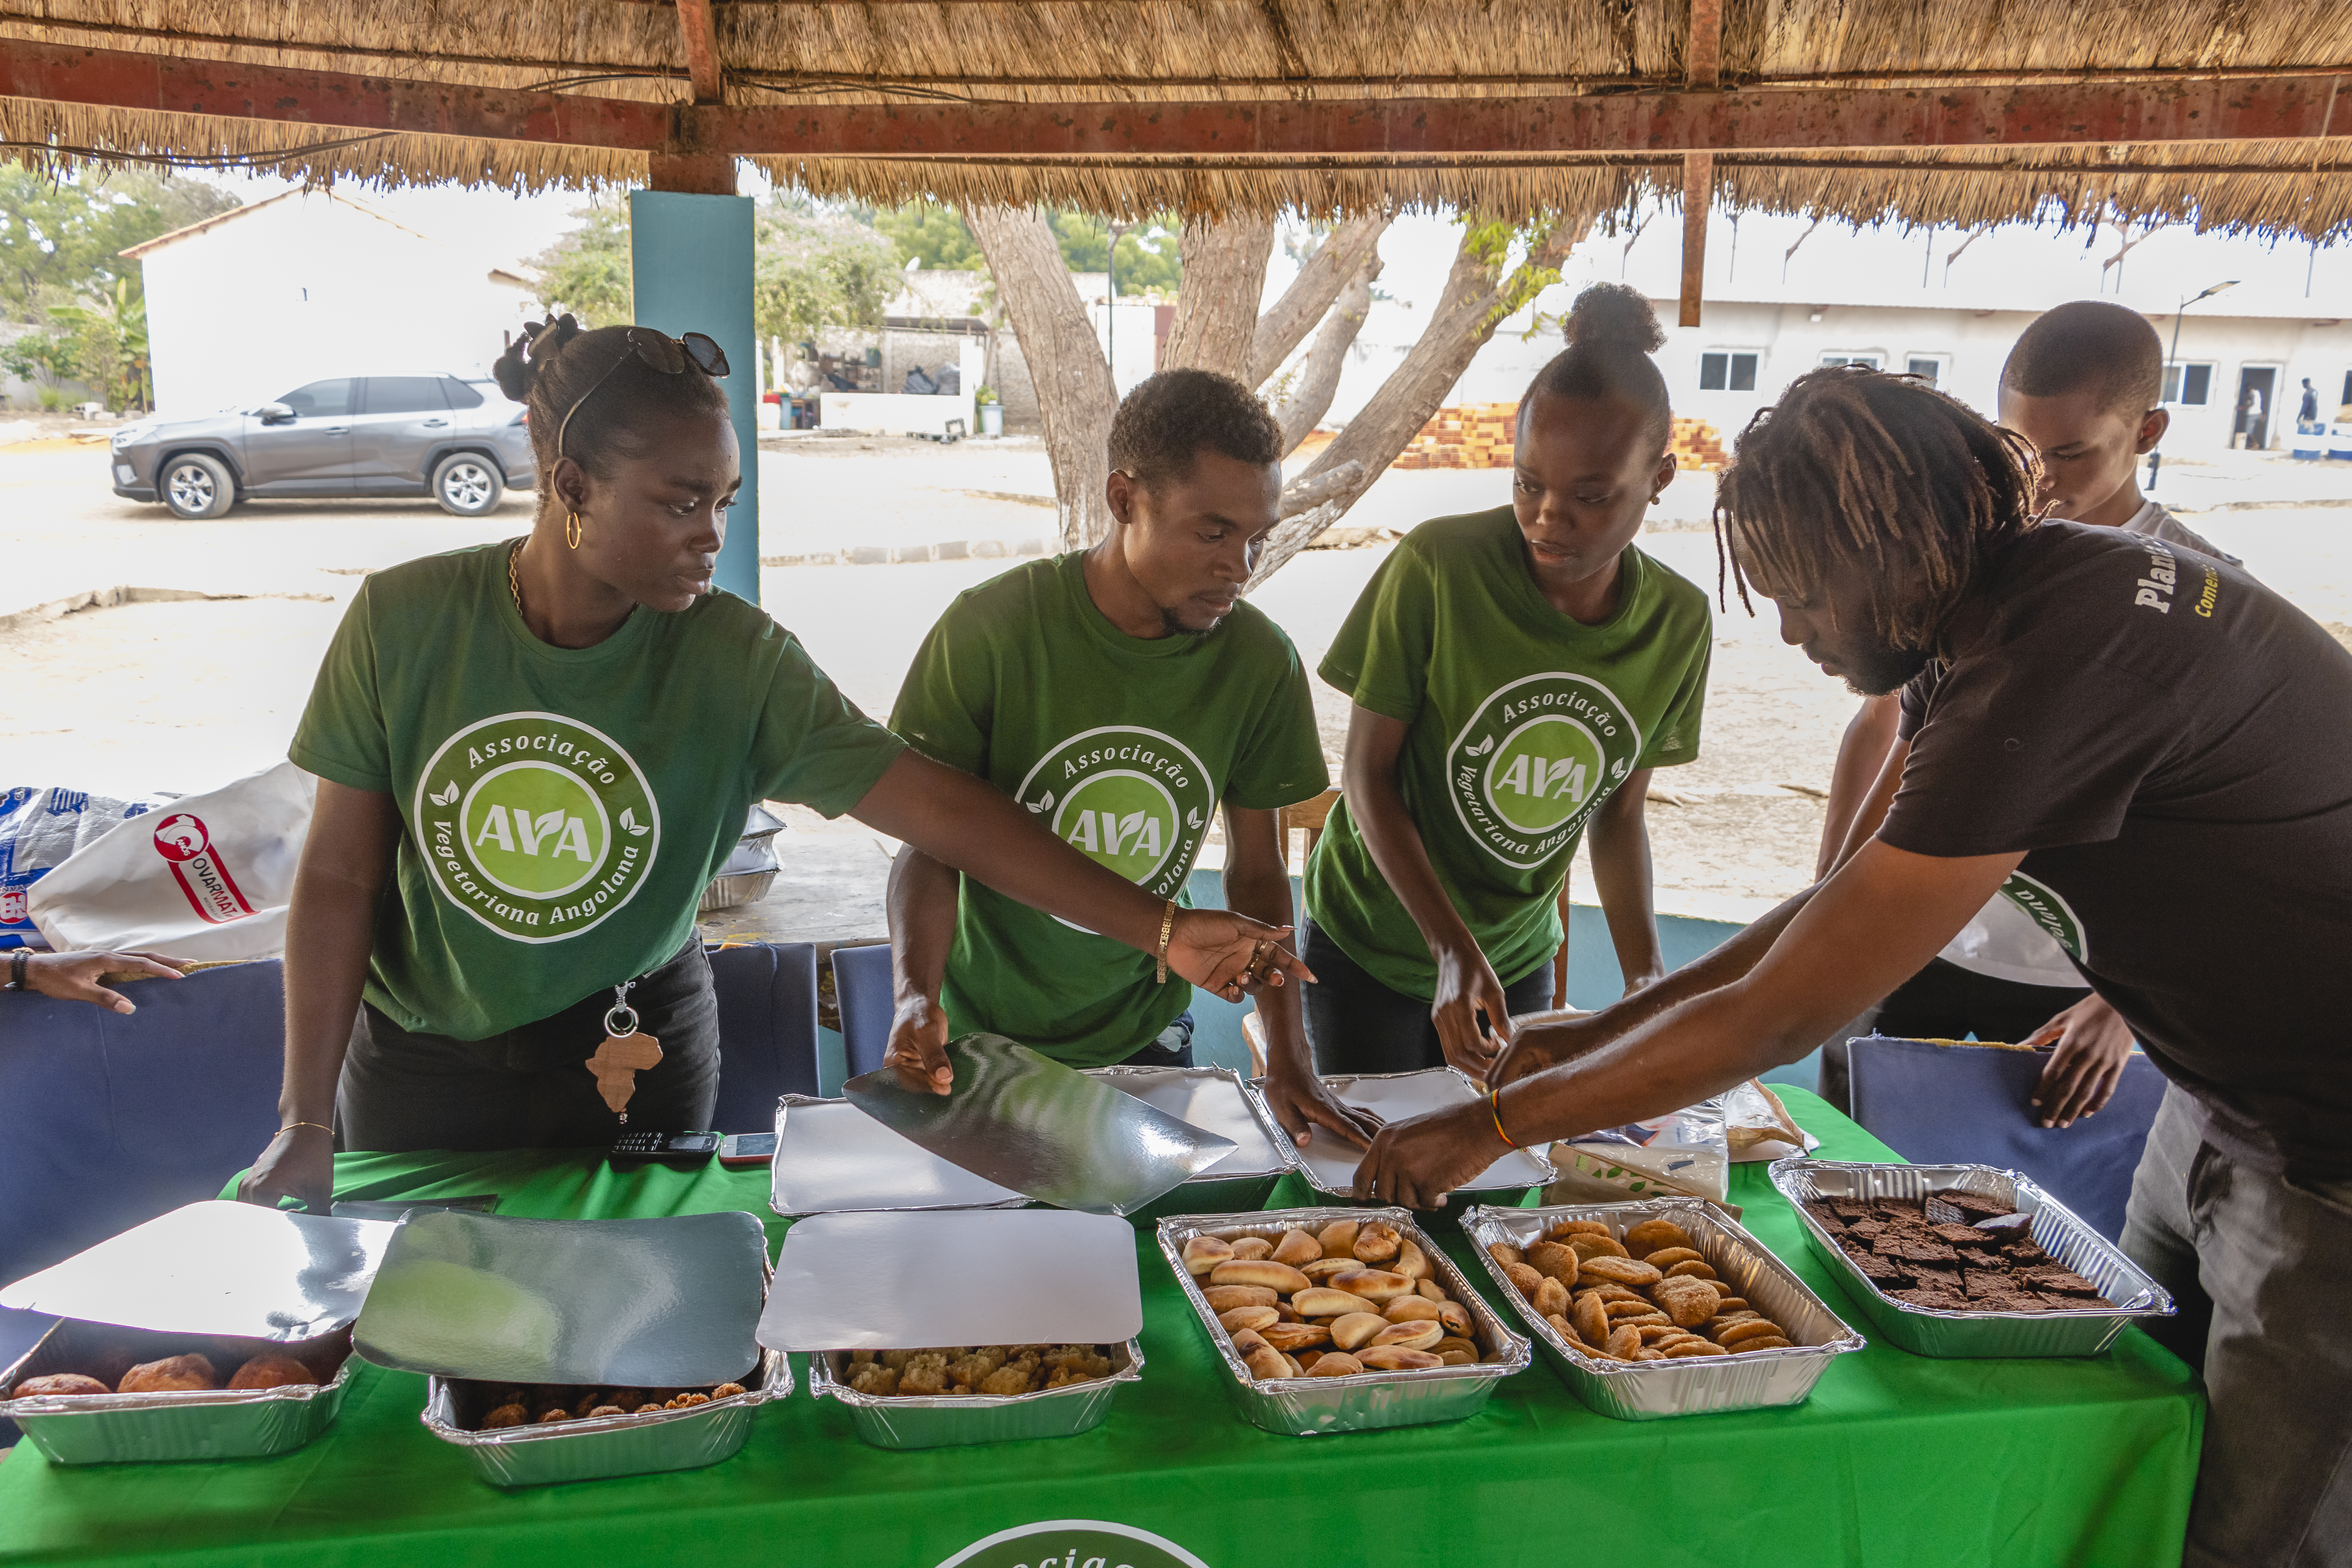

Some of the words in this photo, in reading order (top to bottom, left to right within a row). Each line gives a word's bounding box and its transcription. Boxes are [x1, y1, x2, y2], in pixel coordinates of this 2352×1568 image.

[1504, 691, 1617, 737] Associação
[468, 733, 615, 784] Associação
[1063, 744, 1188, 788] Associação
[1494, 753, 1586, 802] AVA
[475, 804, 592, 863] AVA
[1067, 809, 1161, 857] AVA
[1458, 765, 1530, 854] Vegetariana
[1533, 786, 1612, 855] Angolana
[175, 839, 190, 856] ANOS
[434, 820, 539, 925] Vegetariana
[548, 845, 639, 925] Angolana
[1152, 839, 1193, 895] olana
